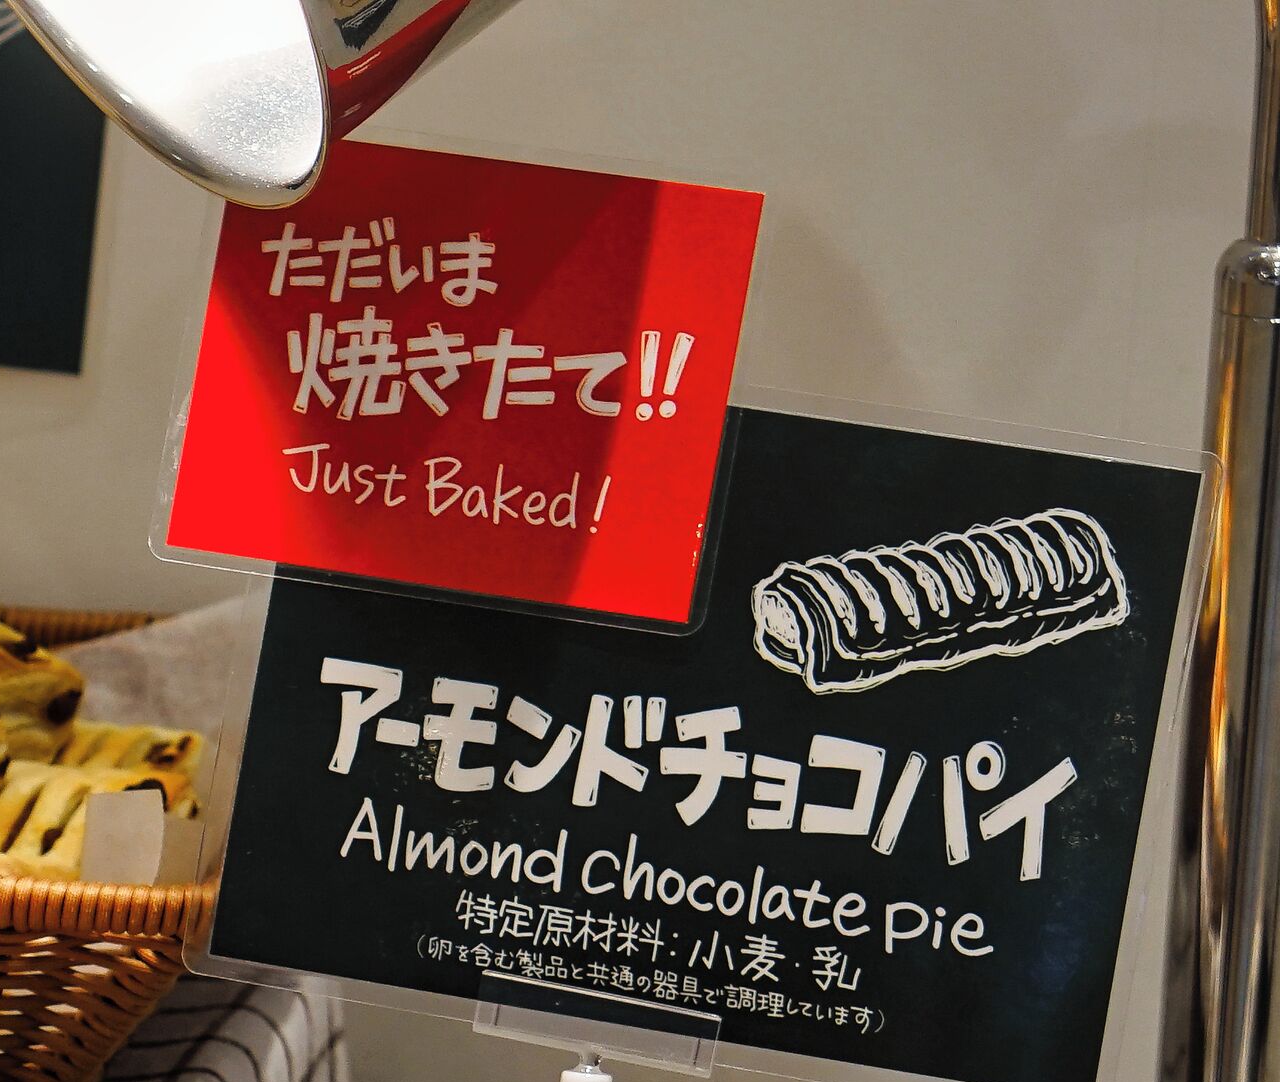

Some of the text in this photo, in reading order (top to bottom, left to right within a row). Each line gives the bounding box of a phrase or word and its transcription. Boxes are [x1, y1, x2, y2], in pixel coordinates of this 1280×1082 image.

[261, 216, 499, 308] ただいま
[286, 304, 696, 422] 焼きたて!!
[281, 443, 612, 534] Just Baked!
[320, 656, 1078, 882] アーモンドチョコパイ
[340, 797, 568, 894] Almond
